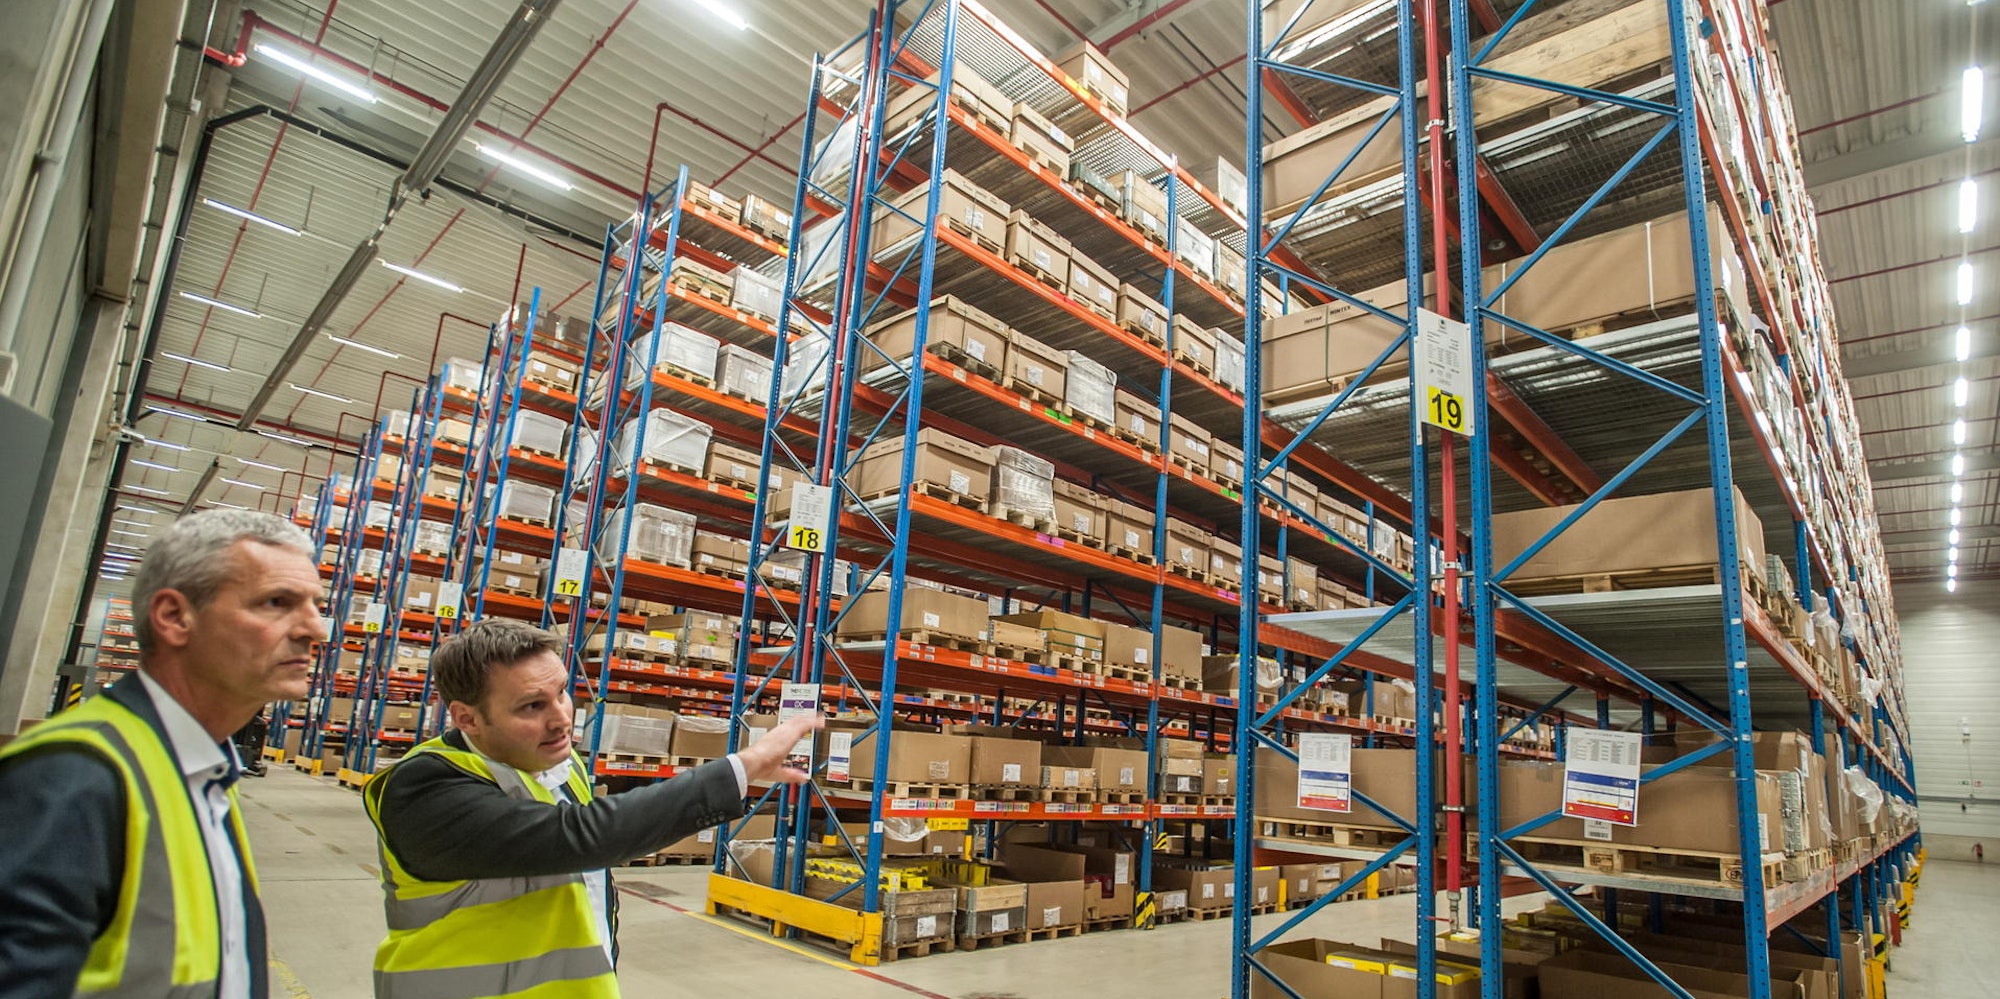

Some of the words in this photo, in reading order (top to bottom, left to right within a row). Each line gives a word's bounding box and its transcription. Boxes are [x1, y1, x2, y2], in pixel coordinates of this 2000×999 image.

[1431, 393, 1462, 429] 19
[795, 529, 819, 550] 18
[560, 581, 578, 594] 17
[439, 606, 454, 617] 16
[366, 622, 379, 631] 15
